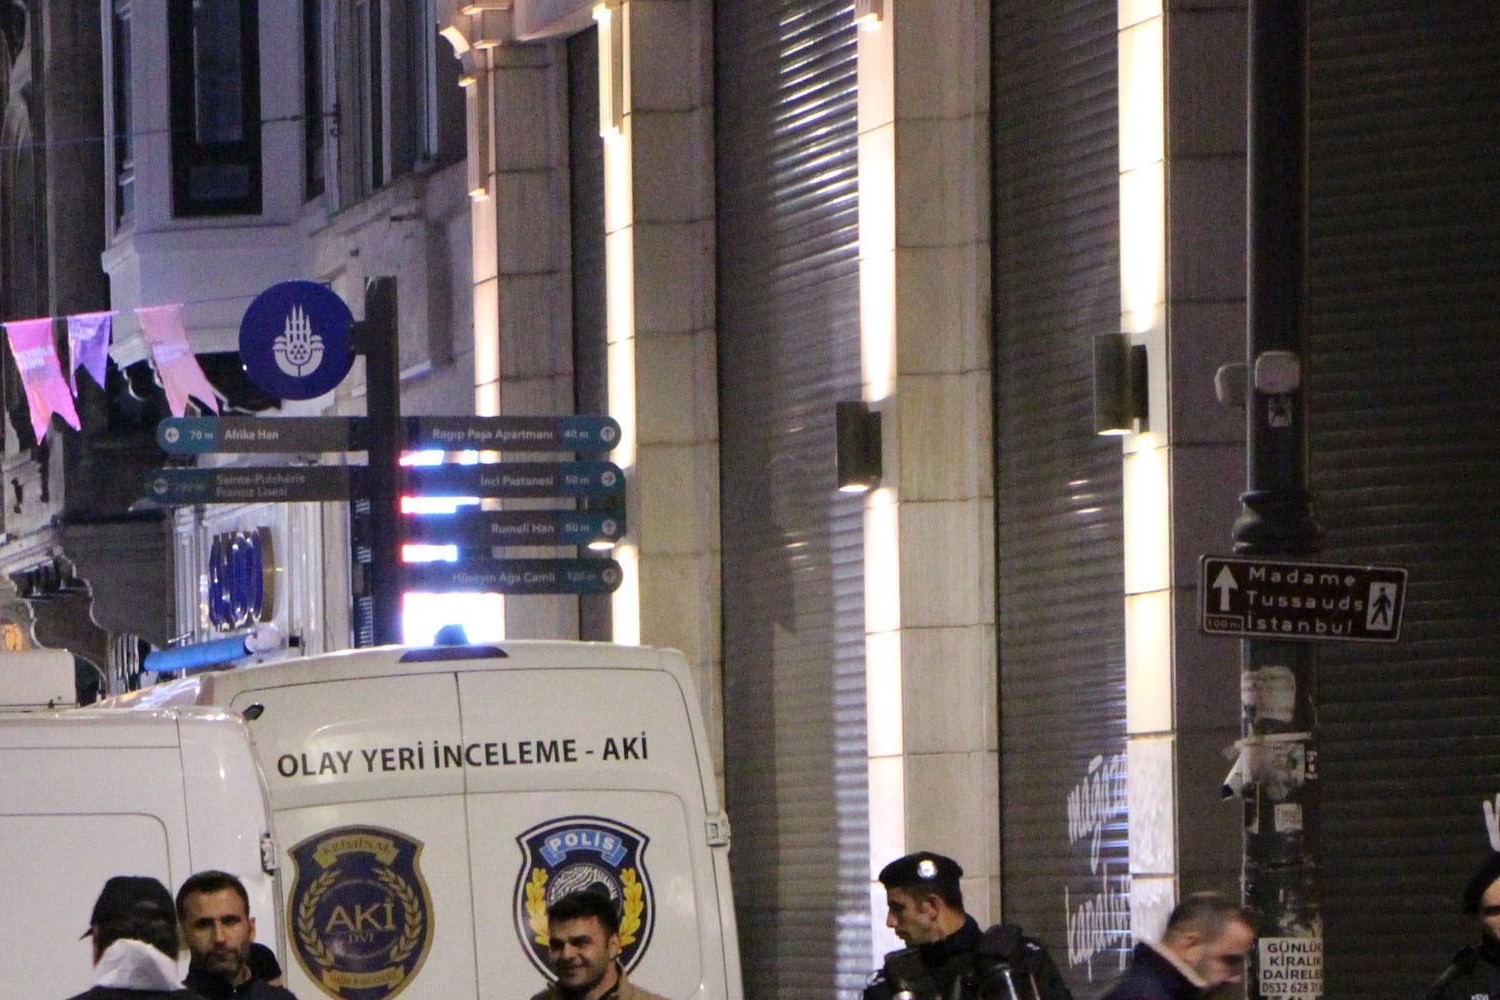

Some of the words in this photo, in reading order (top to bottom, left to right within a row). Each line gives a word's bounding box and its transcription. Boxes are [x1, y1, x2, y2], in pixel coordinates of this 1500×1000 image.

[224, 429, 257, 440] Afrika
[259, 430, 279, 440] Han
[503, 475, 554, 486] Pastanesi
[533, 524, 554, 533] Han
[1250, 567, 1356, 587] Madame
[1247, 590, 1363, 611] Tussauds
[1248, 611, 1352, 634] İstanbul
[277, 750, 352, 778] OLAY
[360, 742, 424, 773] YERİ
[432, 738, 578, 769] İNCELEME
[602, 731, 648, 761] AKİ
[550, 831, 615, 852] POLİS
[324, 897, 396, 933] AKİ
